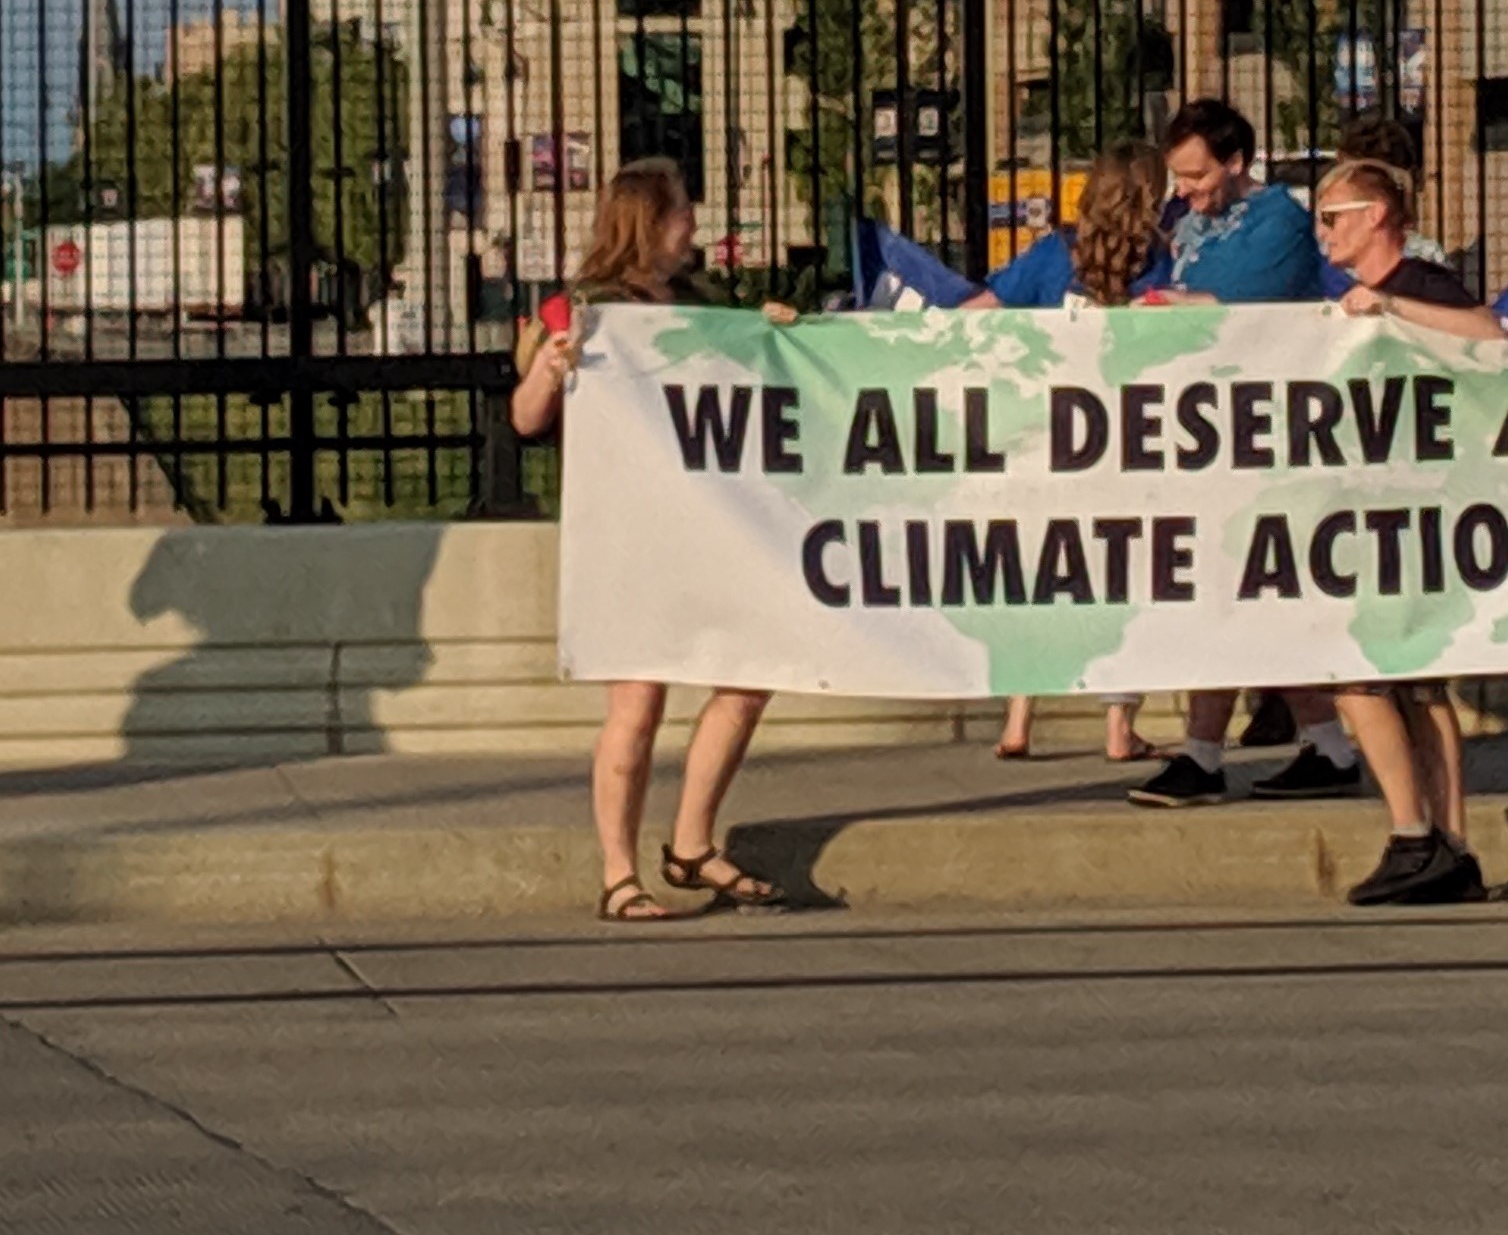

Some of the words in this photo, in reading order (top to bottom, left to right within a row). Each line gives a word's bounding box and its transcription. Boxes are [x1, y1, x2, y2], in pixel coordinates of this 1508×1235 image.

[662, 384, 804, 474] WE
[842, 386, 1006, 475] ALL
[1049, 373, 1456, 473] DESERVE
[800, 516, 1196, 608] CLIMATE
